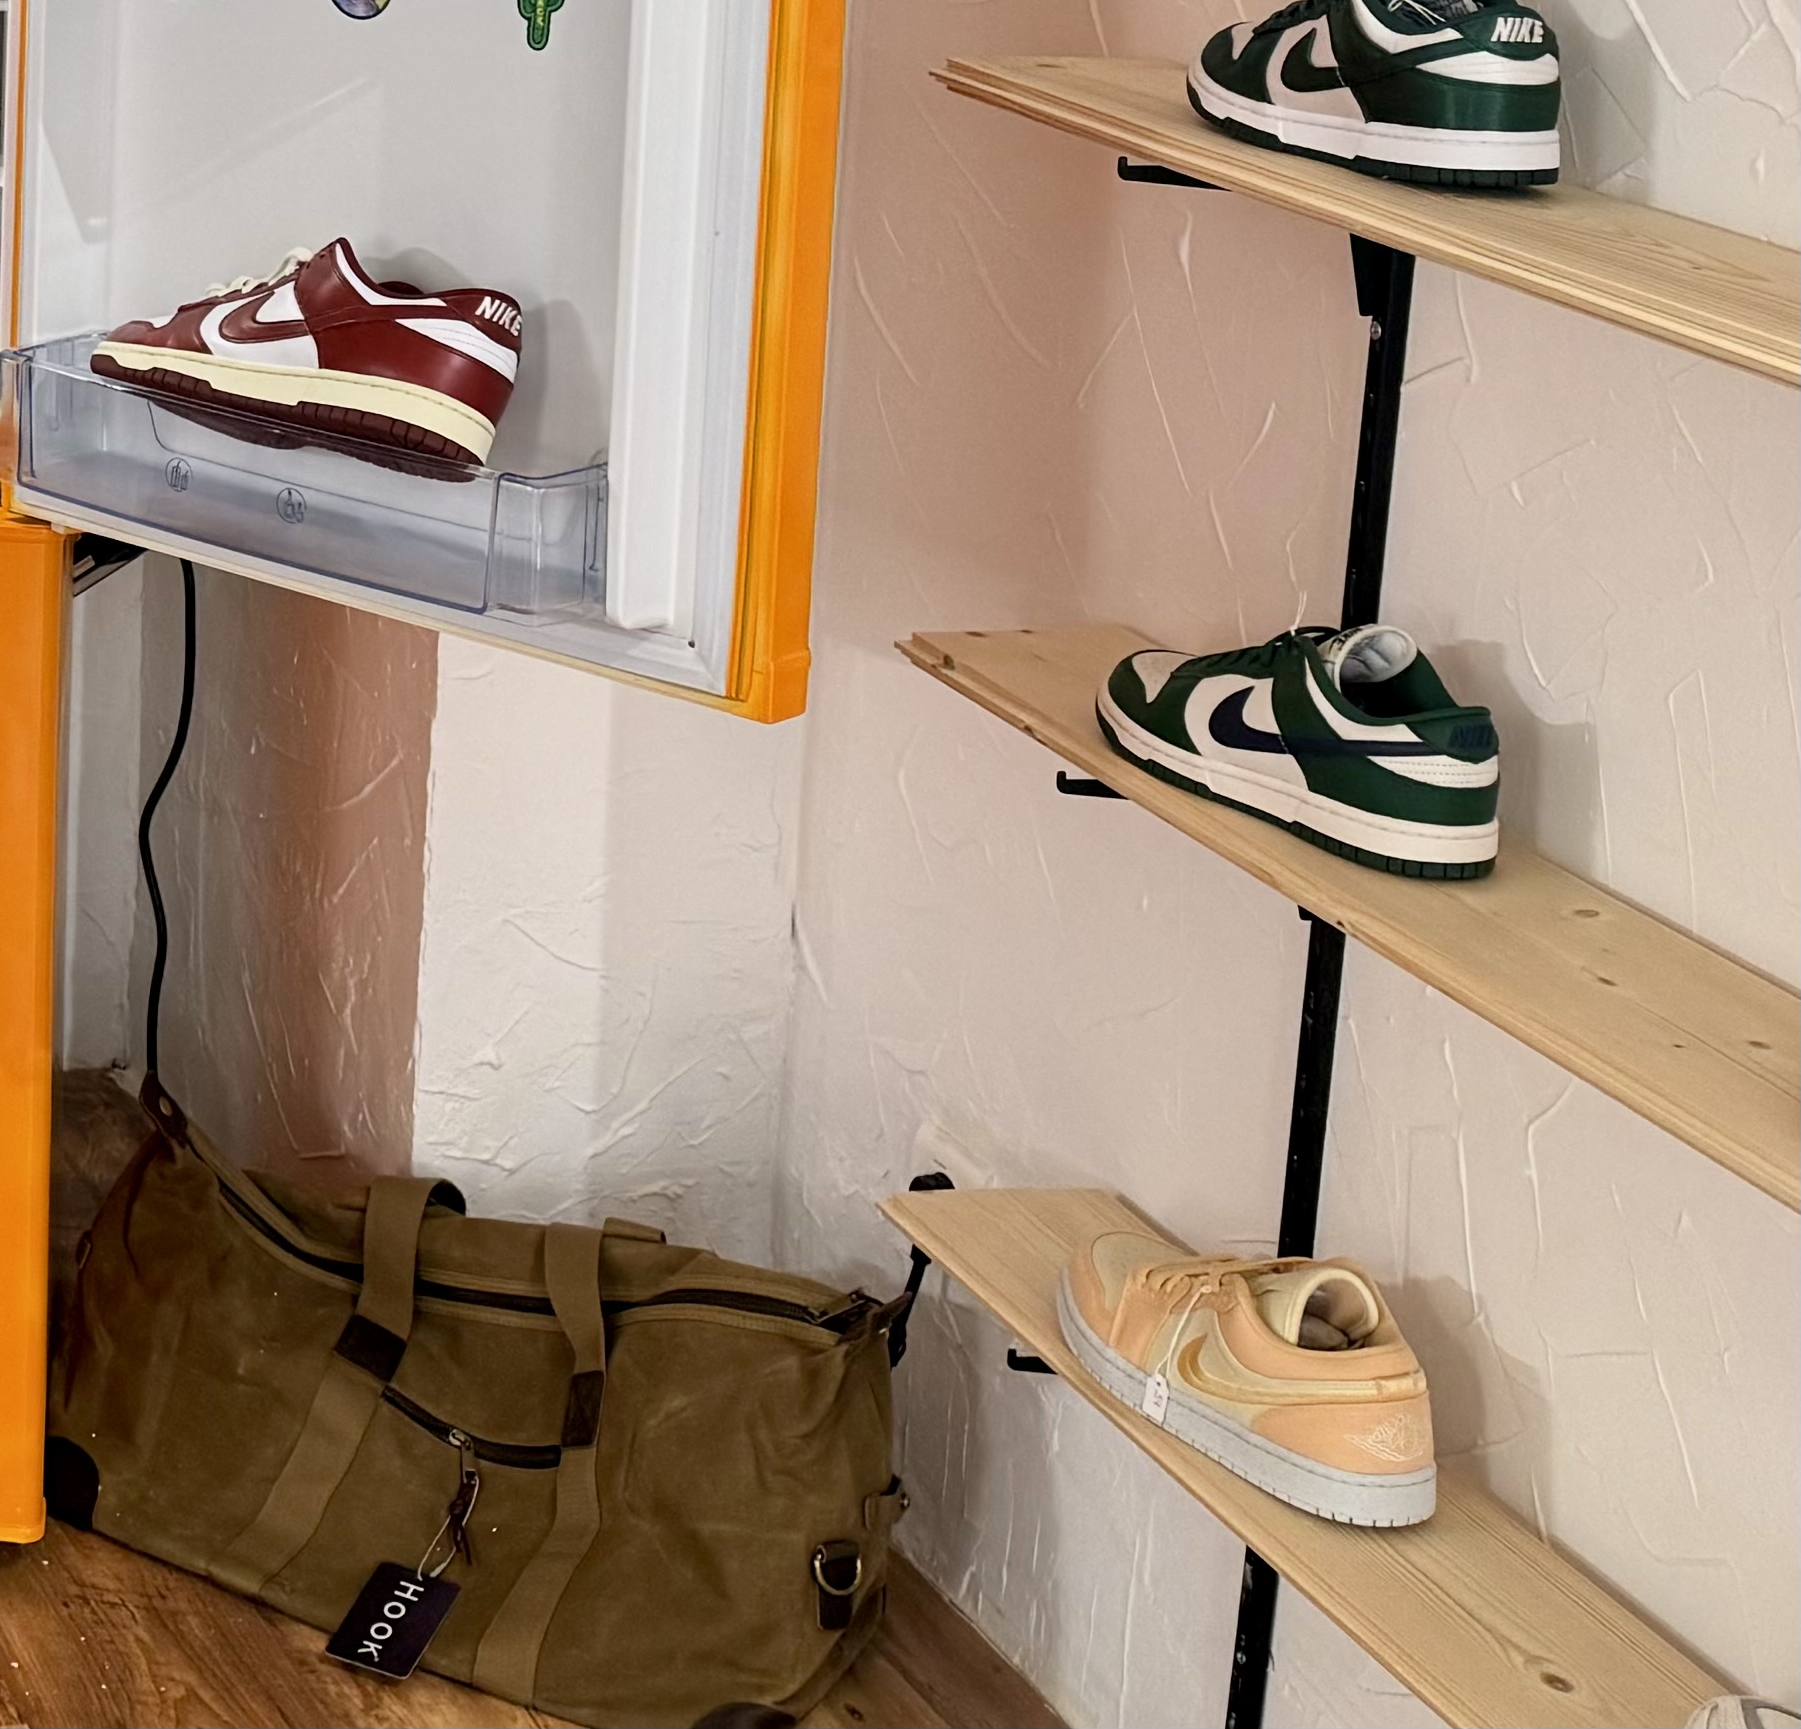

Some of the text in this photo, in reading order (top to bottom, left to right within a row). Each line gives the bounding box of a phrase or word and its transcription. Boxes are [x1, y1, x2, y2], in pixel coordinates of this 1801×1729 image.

[1491, 17, 1544, 43] NIKE
[475, 296, 522, 336] NIKE
[358, 1581, 424, 1660] HOOK
